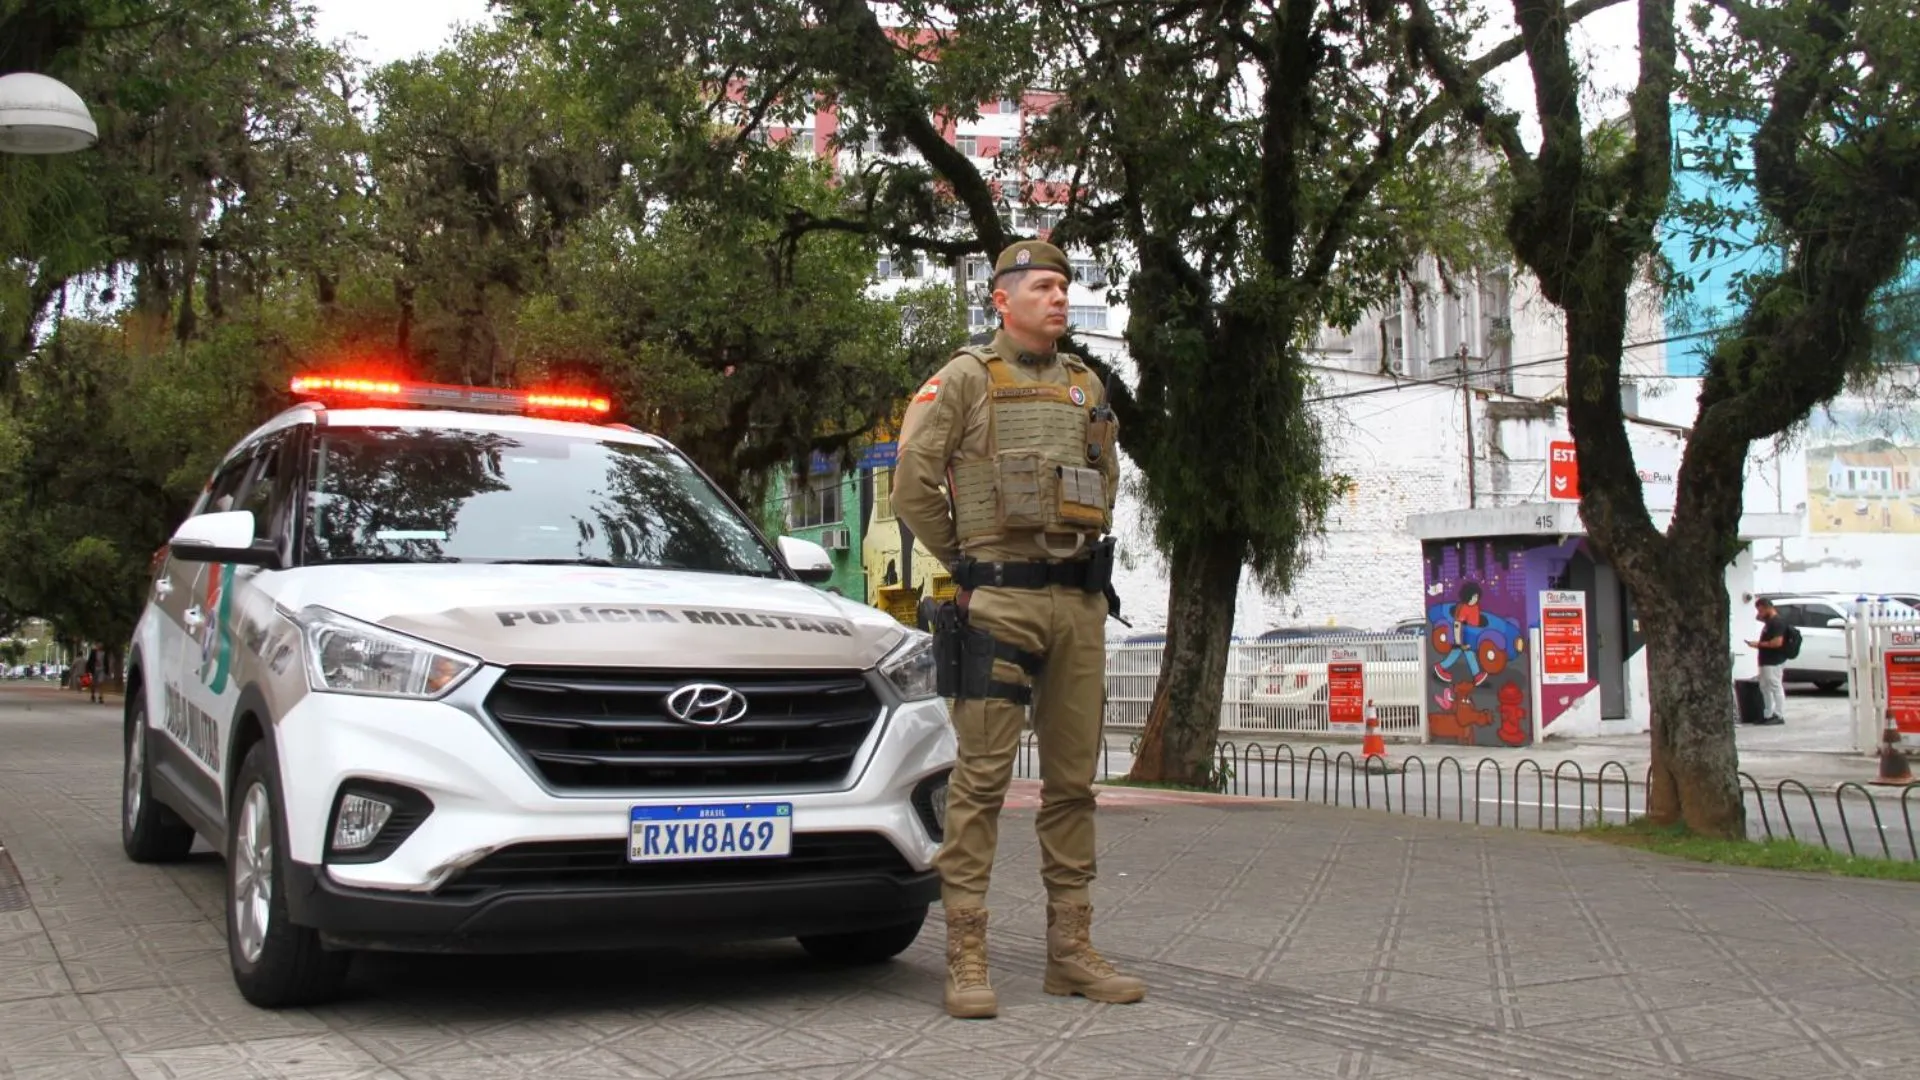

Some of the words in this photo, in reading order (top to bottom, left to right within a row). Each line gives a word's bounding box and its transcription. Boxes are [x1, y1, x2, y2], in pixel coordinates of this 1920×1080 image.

[1553, 449, 1576, 463] EST
[1535, 515, 1553, 529] 415
[494, 606, 678, 628] POLÍCIA
[681, 609, 853, 637] MILITAR
[699, 808, 726, 818] BRASIL
[643, 821, 774, 855] RXW8A69
[631, 846, 642, 858] BR
